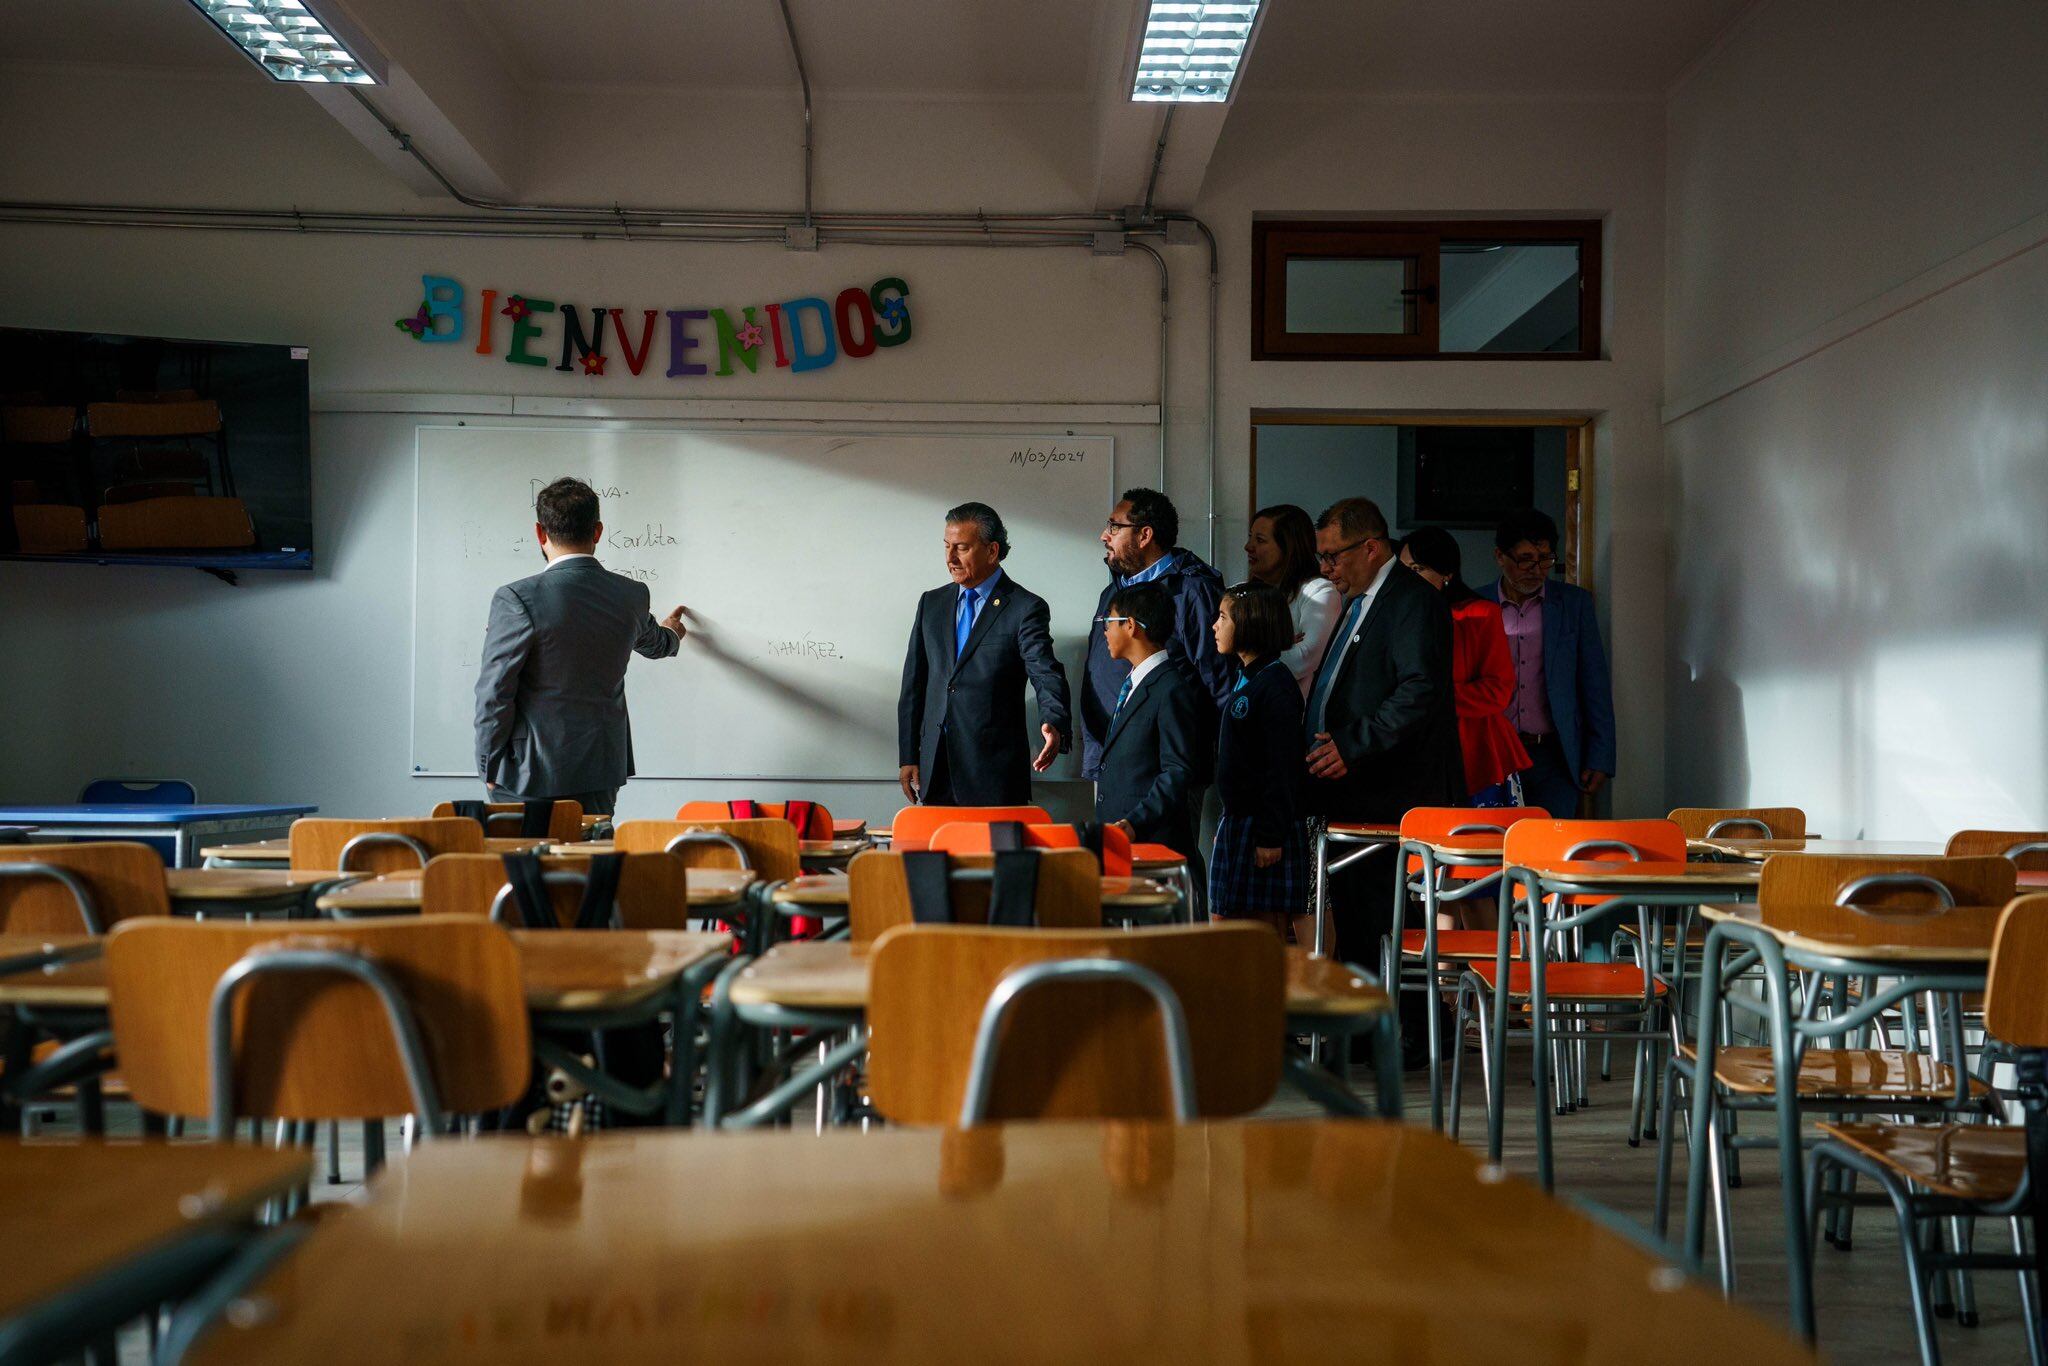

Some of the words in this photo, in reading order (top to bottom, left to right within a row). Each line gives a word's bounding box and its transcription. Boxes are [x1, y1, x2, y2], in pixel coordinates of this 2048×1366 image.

[421, 274, 912, 378] BIENVENIDOS
[1009, 446, 1085, 469] 11/03/2024
[607, 523, 679, 549] Karlita
